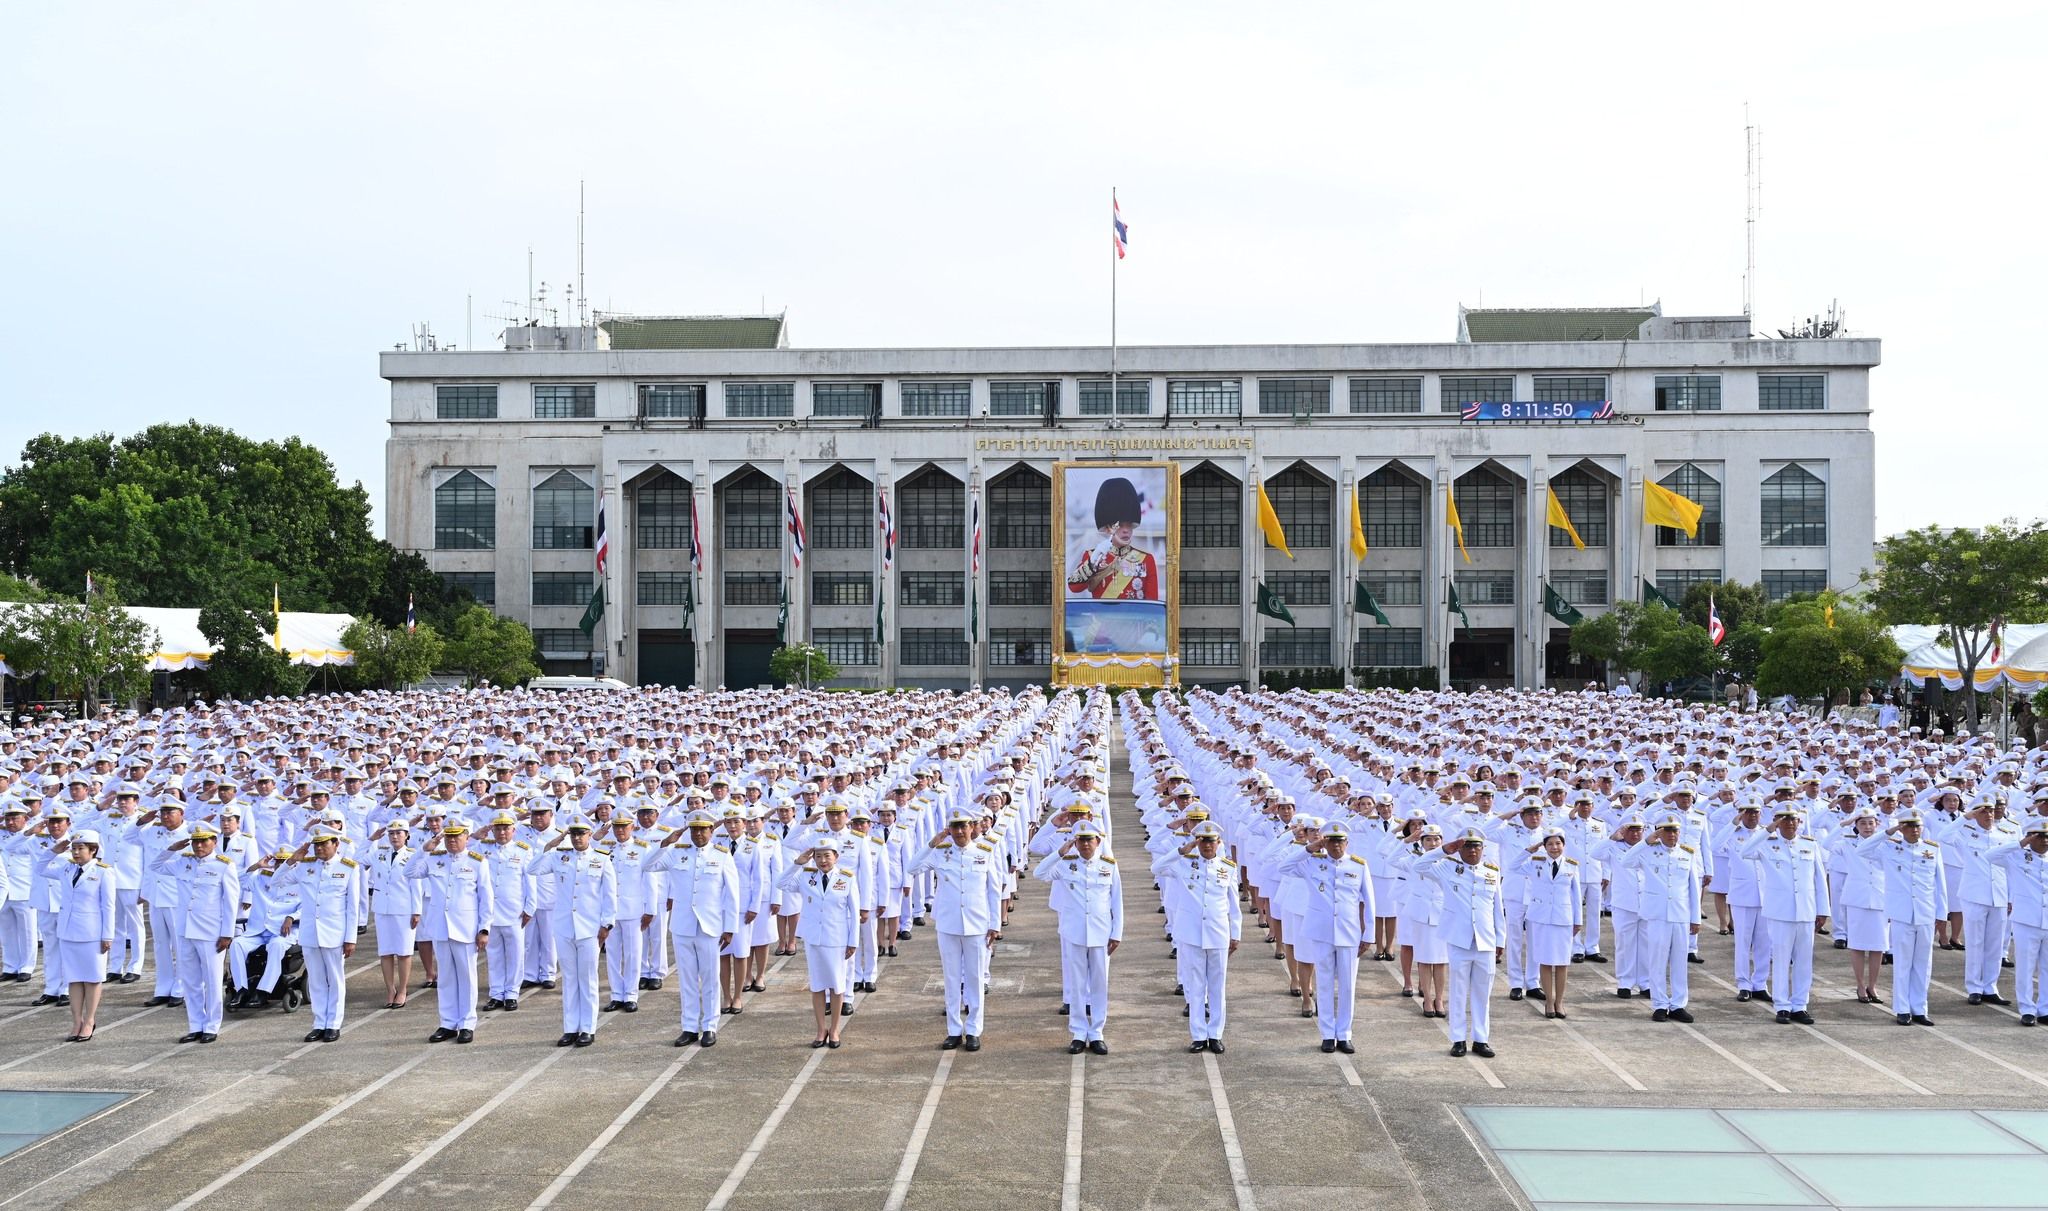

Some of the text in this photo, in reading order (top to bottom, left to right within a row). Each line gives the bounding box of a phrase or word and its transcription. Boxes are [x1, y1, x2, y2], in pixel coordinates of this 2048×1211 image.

[975, 436, 1254, 455] ศาลาว่าการกรุงเทพมหานคร
